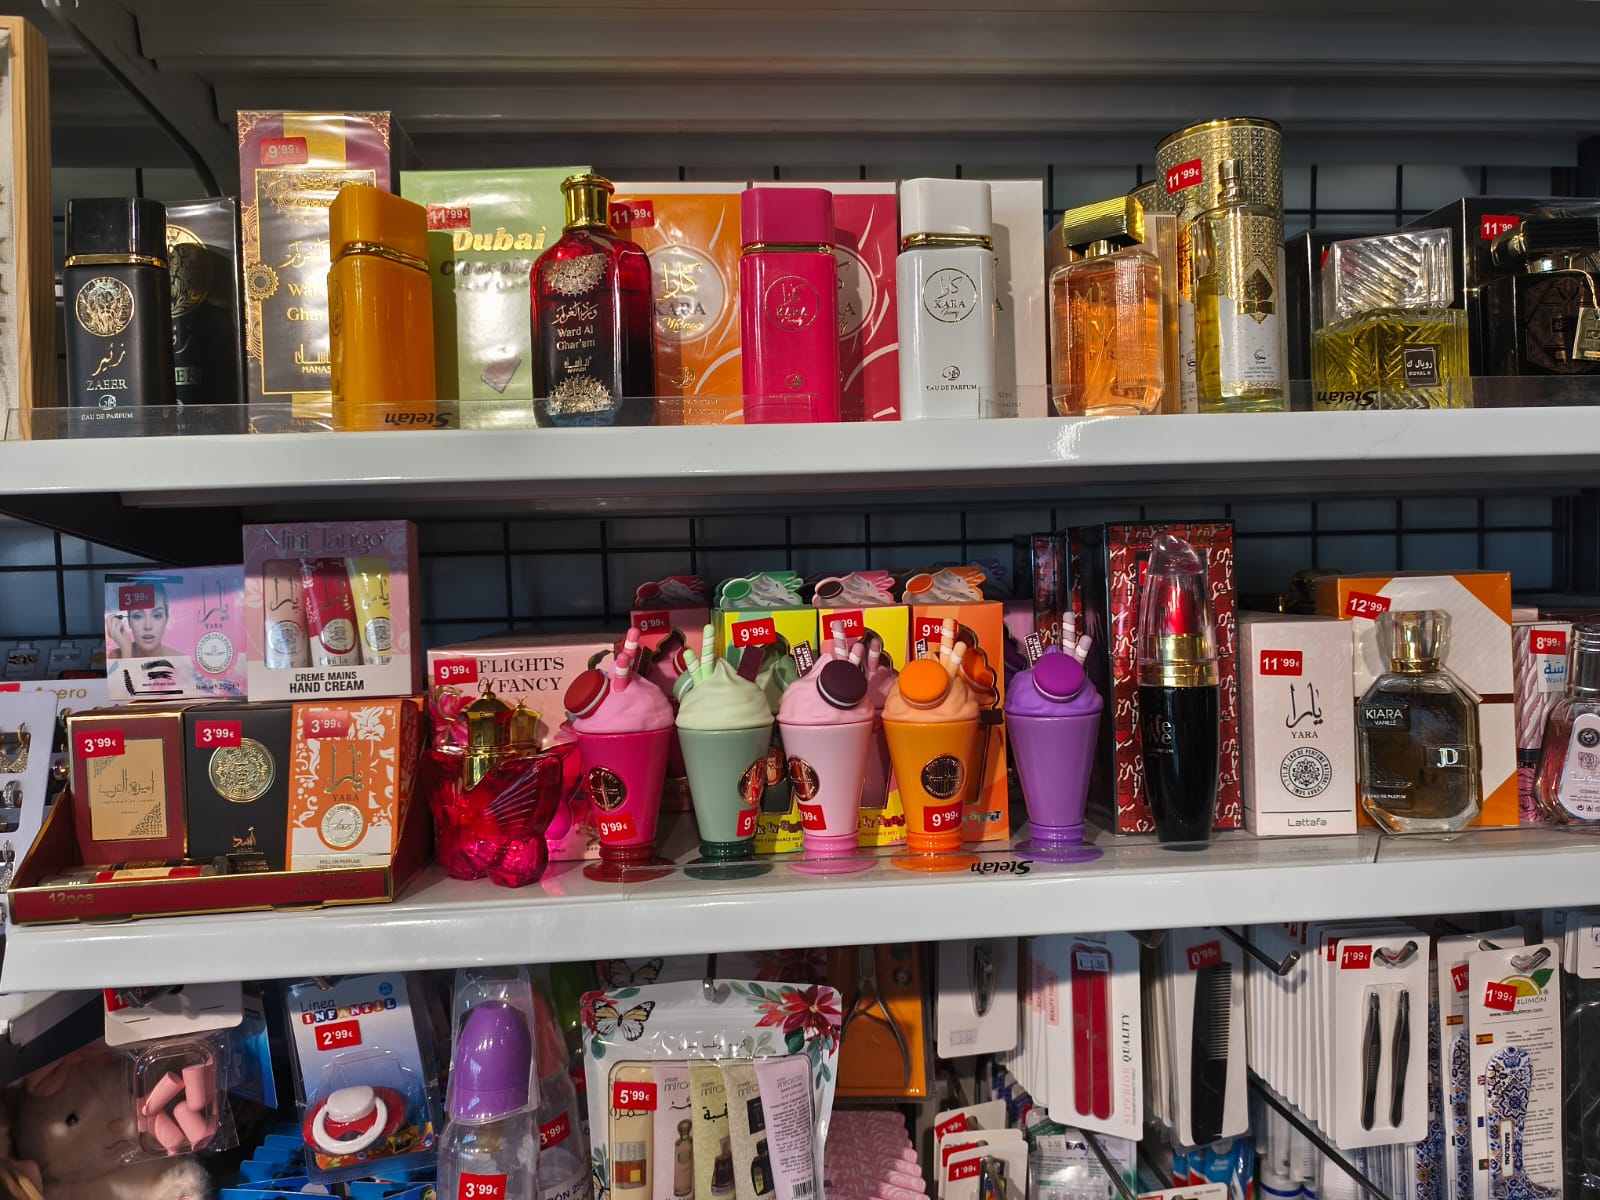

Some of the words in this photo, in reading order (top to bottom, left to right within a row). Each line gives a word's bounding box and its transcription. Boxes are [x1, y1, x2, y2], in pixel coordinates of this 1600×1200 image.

[1168, 168, 1200, 188] 11'99€
[430, 209, 469, 224] 11'99€
[612, 208, 651, 224] 11'99€
[1484, 222, 1513, 235] 11'99
[453, 226, 547, 252] Dubai
[934, 300, 966, 309] KARA
[556, 326, 582, 338] Ward
[584, 325, 594, 335] Al
[740, 626, 770, 642] 9'99€
[478, 656, 565, 674] FLIGHTS
[1262, 657, 1300, 671] 11'99€
[295, 673, 325, 682] CREME
[328, 671, 357, 680] MAINS
[440, 665, 470, 679] 9'99€
[290, 682, 321, 694] HAND
[325, 680, 364, 692] CREAM
[498, 676, 562, 693] FANCY
[1365, 708, 1404, 720] KIARA
[311, 718, 343, 733] 3'99€
[202, 728, 235, 743] 3'99€
[1290, 731, 1319, 739] YARA
[84, 737, 117, 753] 3'99€
[932, 810, 959, 827] 9'99€
[1288, 817, 1328, 827] Lattafa
[601, 821, 628, 836] 9'99€
[1343, 951, 1368, 964] 1'99€
[1486, 989, 1513, 1003] 1'99€
[303, 999, 396, 1024] INFANTIL
[322, 1029, 353, 1046] 2'99€
[1121, 1013, 1132, 1063] QUALITY
[619, 1089, 651, 1104] 5'99€
[954, 1165, 977, 1178] 1'99€
[464, 1182, 499, 1198] 3'99€
